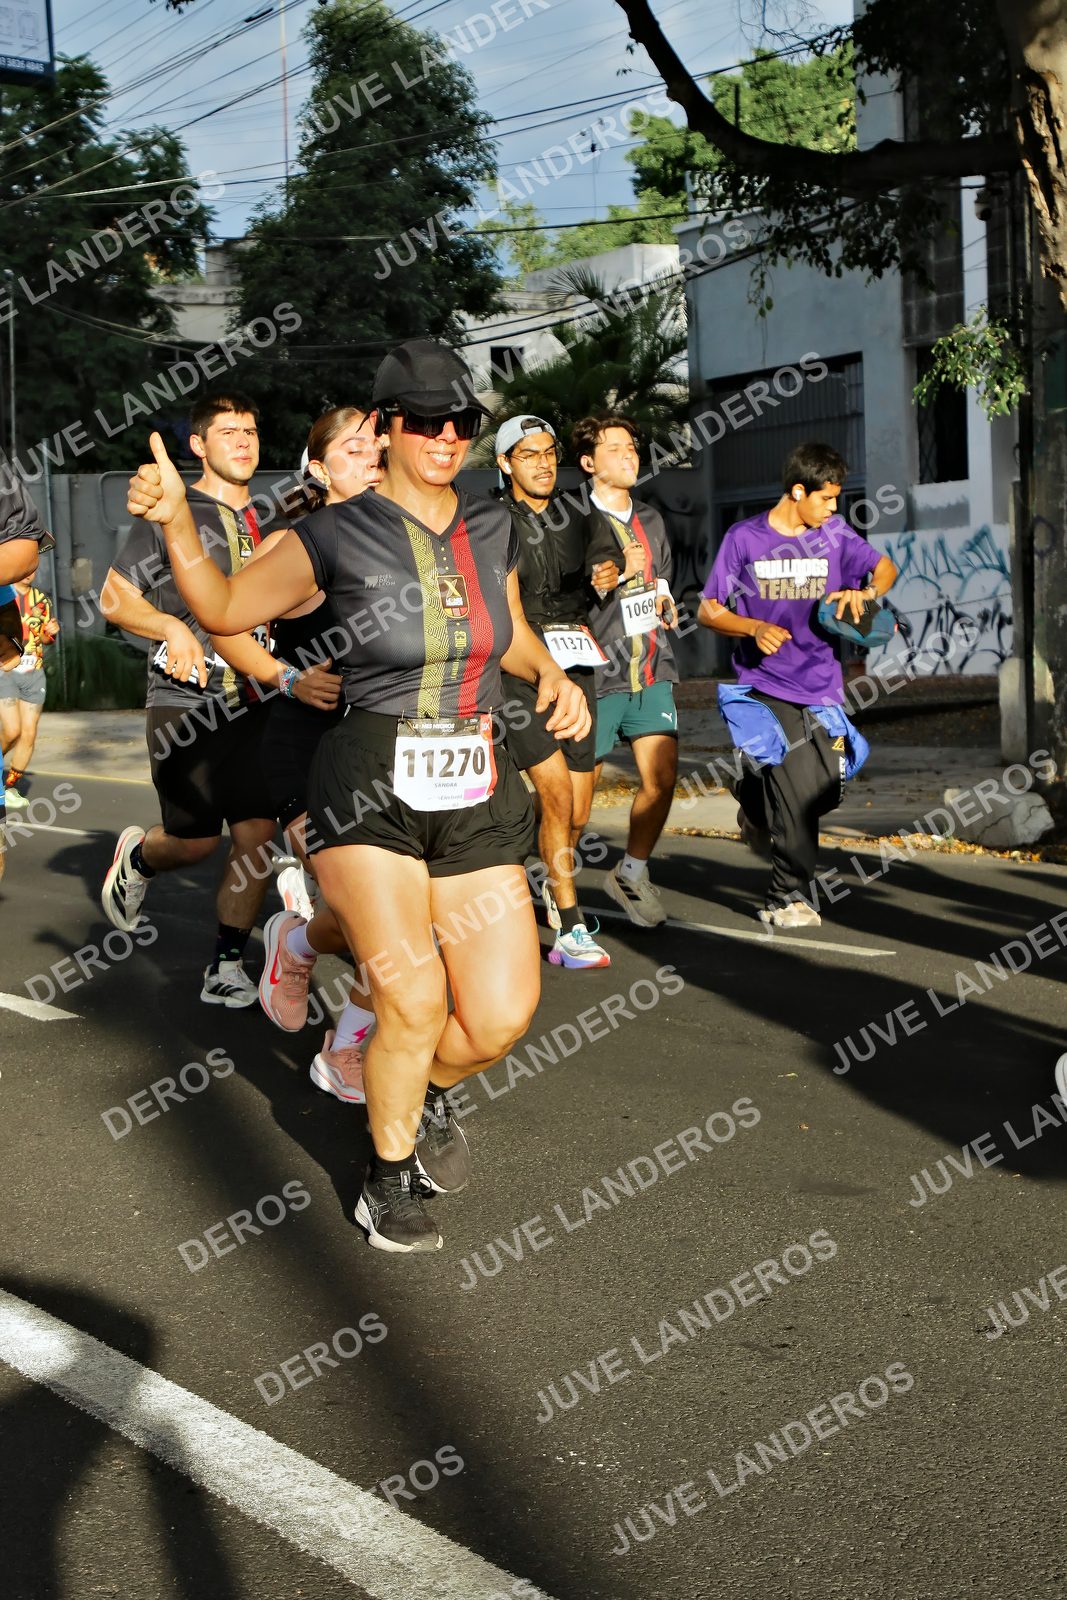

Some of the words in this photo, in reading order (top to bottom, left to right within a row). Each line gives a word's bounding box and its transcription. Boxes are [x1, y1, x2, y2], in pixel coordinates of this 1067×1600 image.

[754, 558, 829, 579] BULLDOGS
[757, 577, 828, 600] TENNIS
[626, 596, 656, 619] 1069
[551, 637, 592, 651] 11371
[402, 745, 486, 778] 11270
